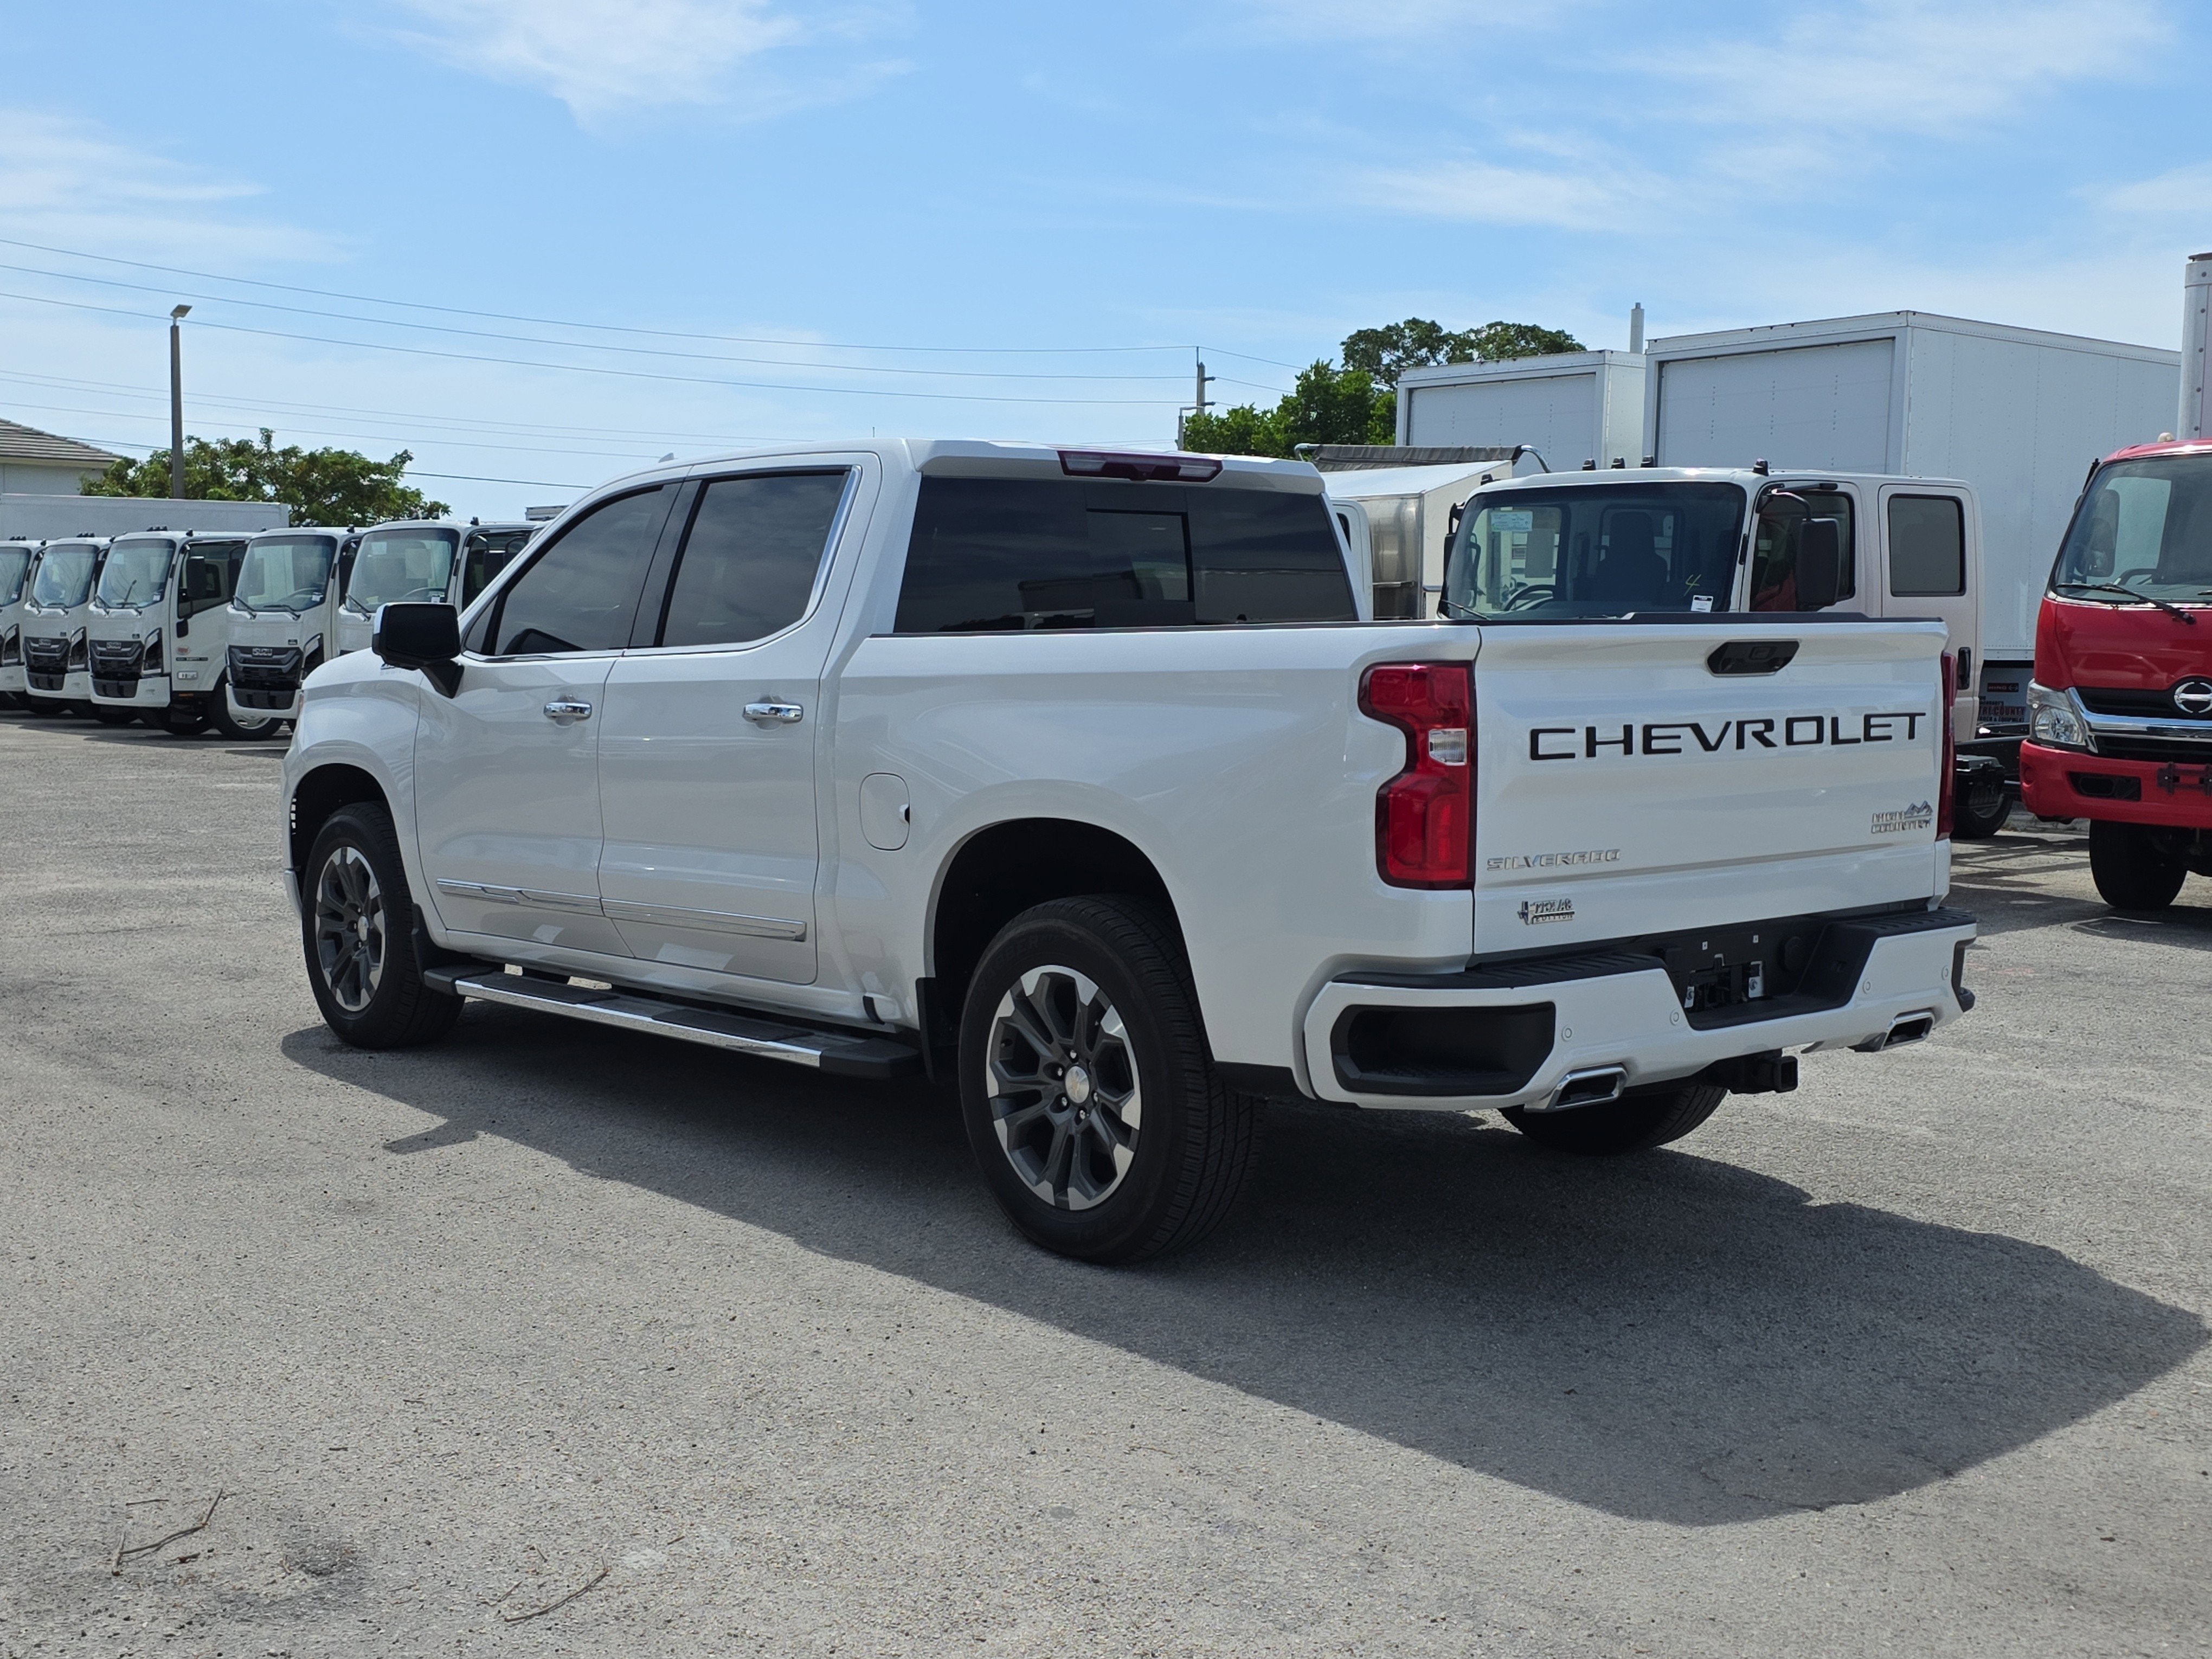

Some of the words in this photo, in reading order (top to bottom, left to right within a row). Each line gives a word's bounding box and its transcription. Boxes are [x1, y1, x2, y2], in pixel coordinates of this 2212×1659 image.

[1683, 574, 1701, 597] 4
[1530, 712, 1926, 761] CHEVROLET
[1871, 818, 1932, 834] COUNTRY
[1872, 811, 1905, 824] HIGH
[1487, 848, 1621, 871] SILVERADO
[1530, 898, 1573, 915] TEXAS
[1535, 913, 1573, 923] EDITION
